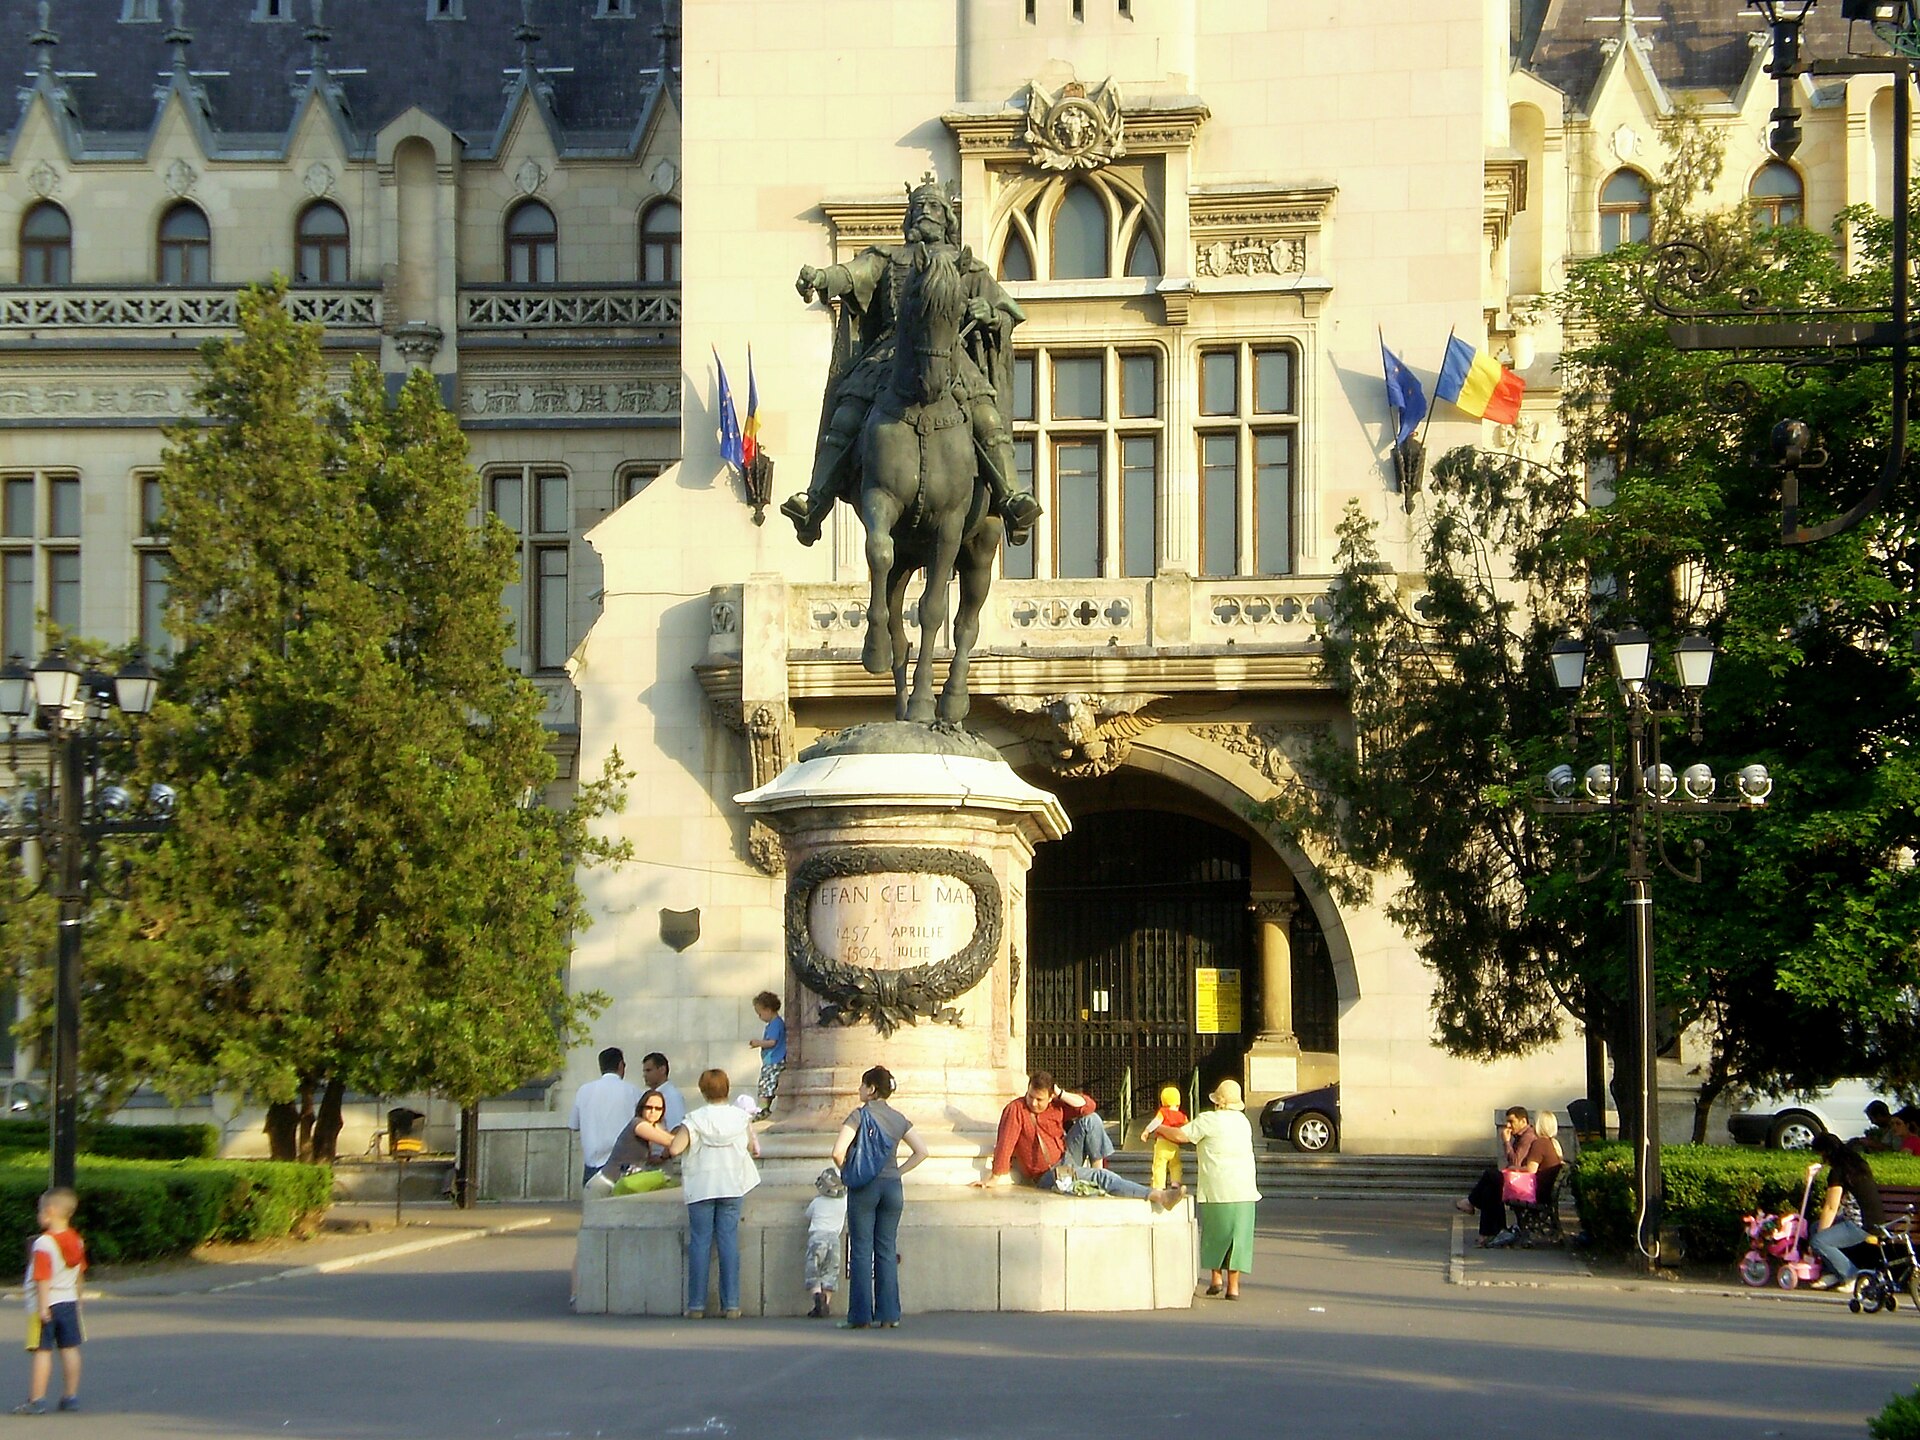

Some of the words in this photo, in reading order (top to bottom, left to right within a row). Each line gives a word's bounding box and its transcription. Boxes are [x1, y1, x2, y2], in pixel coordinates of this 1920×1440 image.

[880, 885, 922, 903] CEL
[836, 926, 870, 942] 1457
[891, 926, 944, 939] APRILIE
[847, 946, 879, 962] 1504
